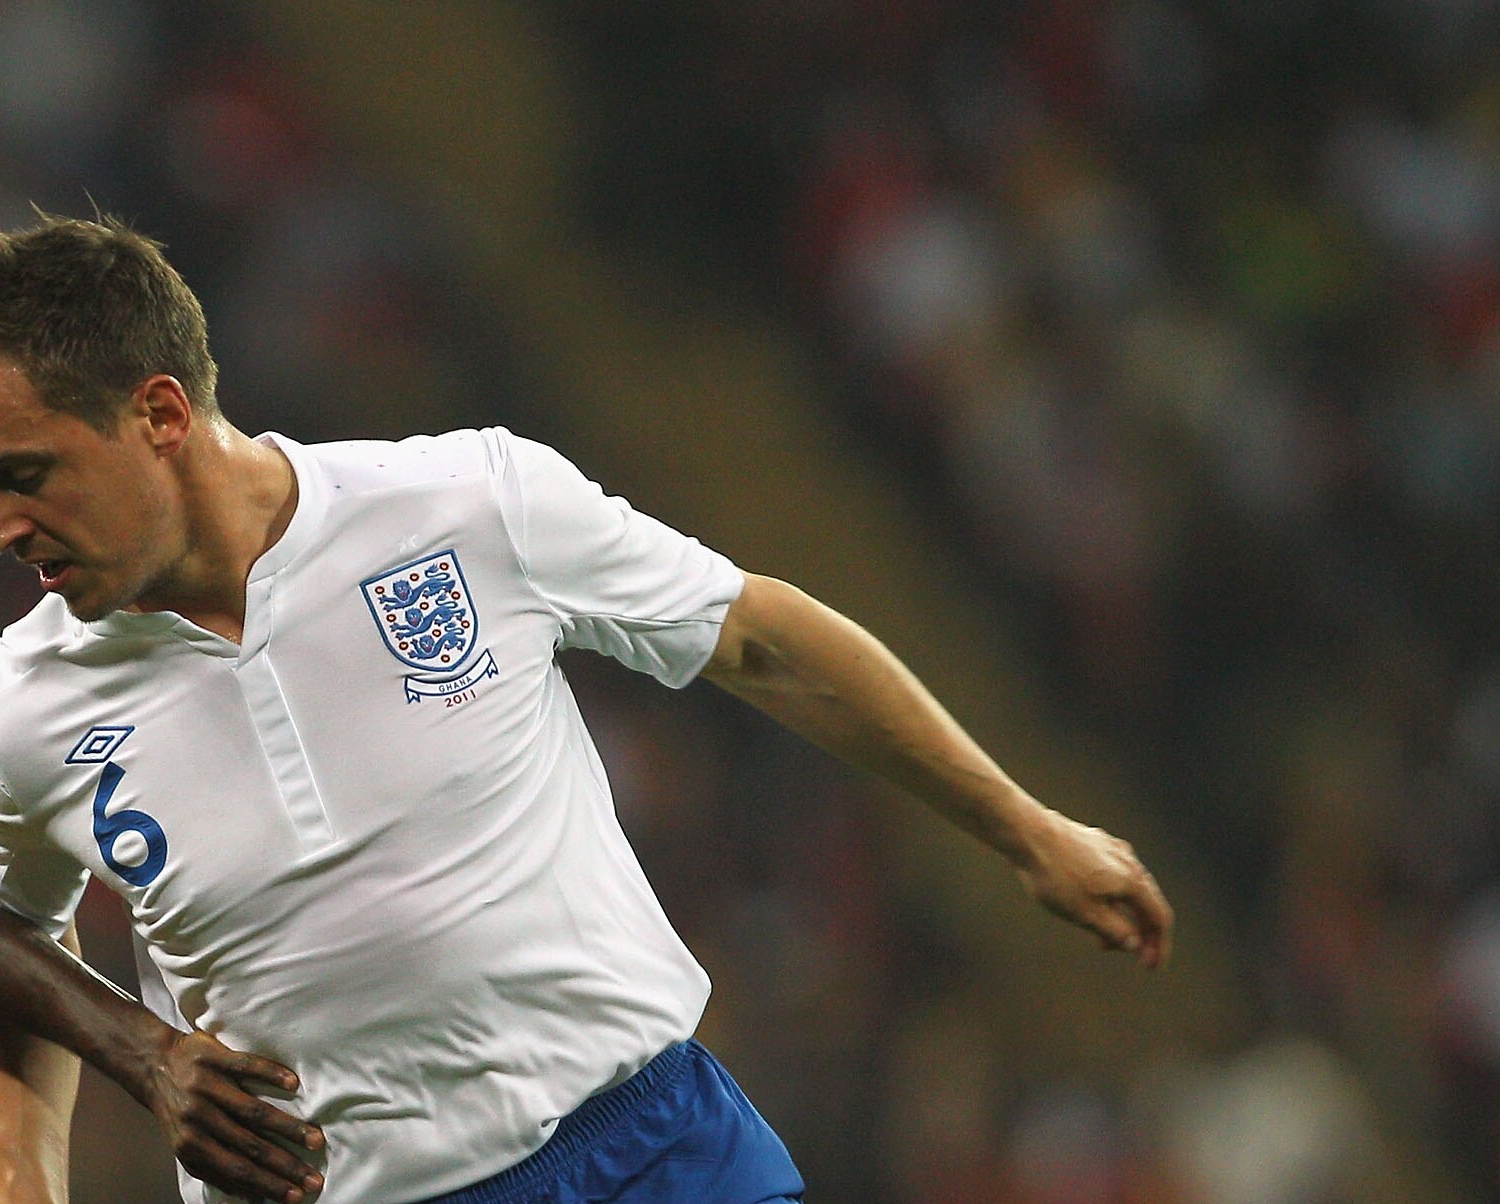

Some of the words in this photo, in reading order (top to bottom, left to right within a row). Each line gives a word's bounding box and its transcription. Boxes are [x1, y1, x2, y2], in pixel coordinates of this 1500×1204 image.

[438, 675, 473, 693] GHANA
[444, 688, 476, 708] 2011
[93, 760, 168, 888] 6
